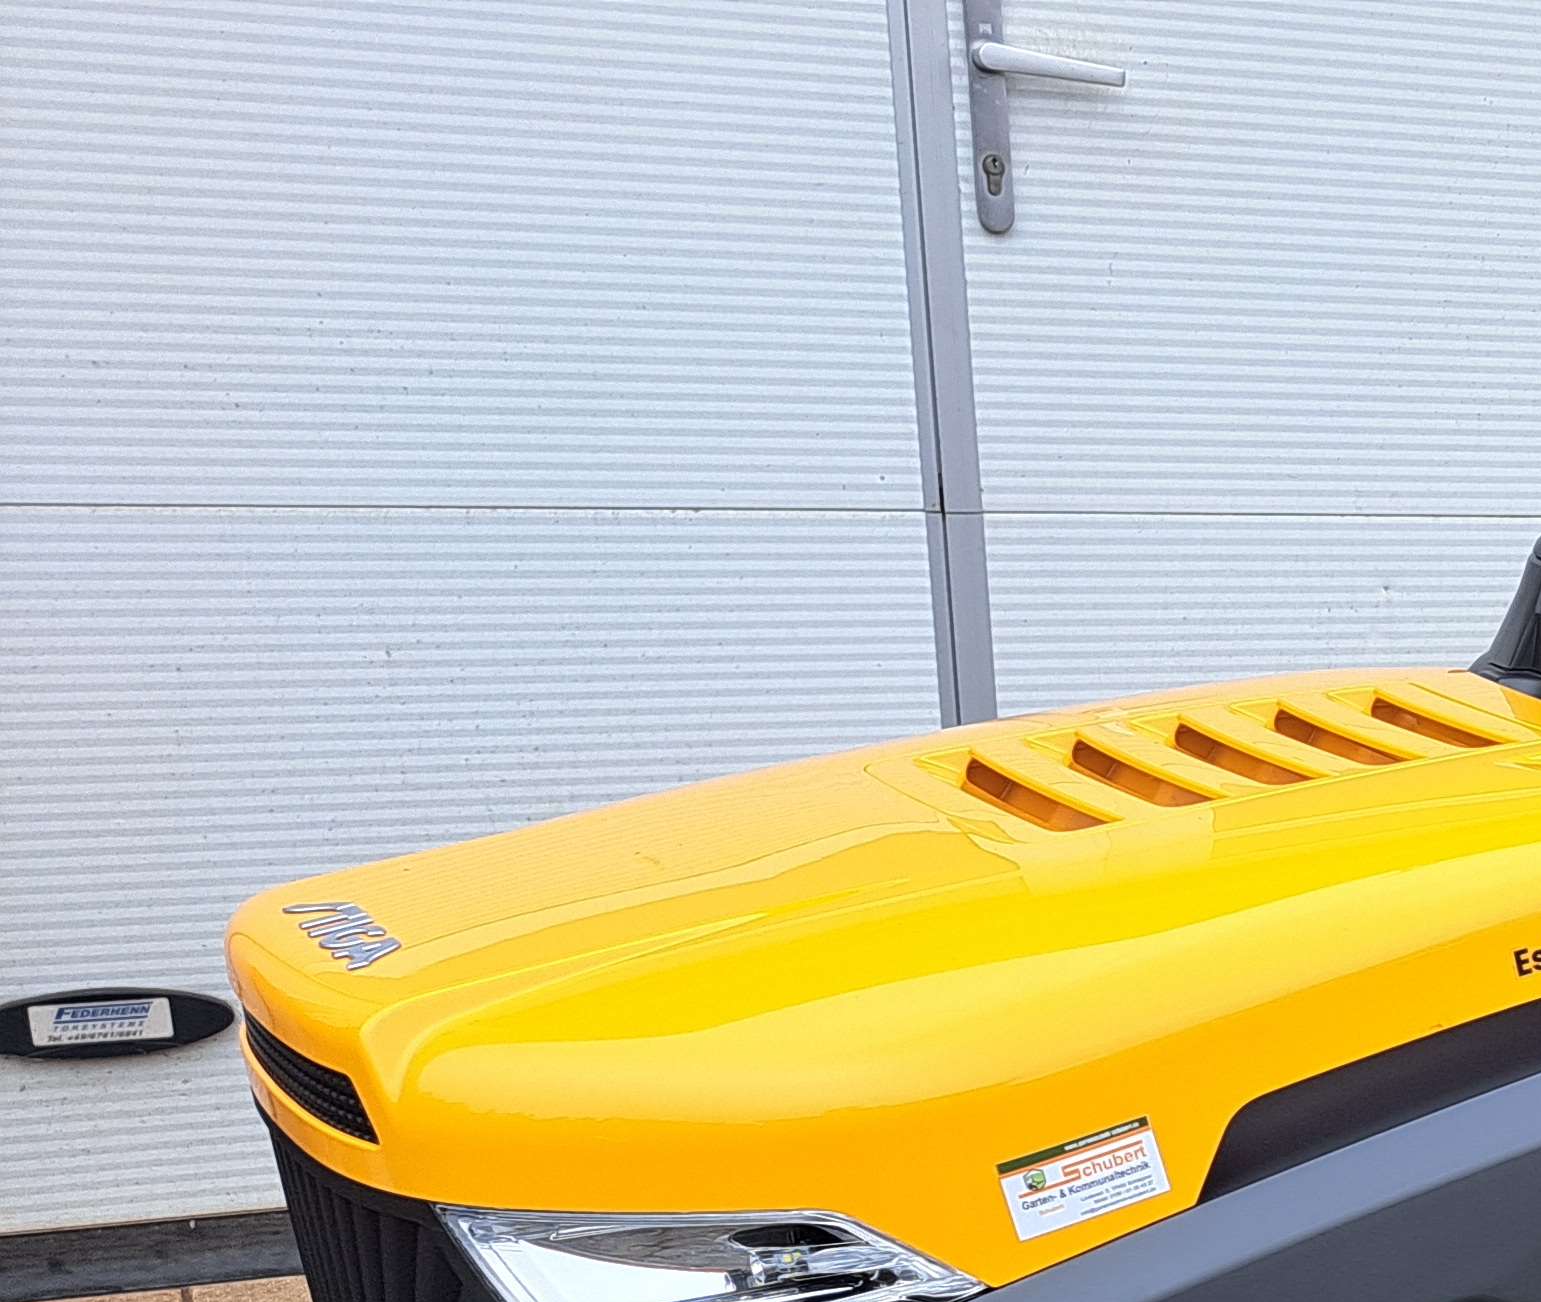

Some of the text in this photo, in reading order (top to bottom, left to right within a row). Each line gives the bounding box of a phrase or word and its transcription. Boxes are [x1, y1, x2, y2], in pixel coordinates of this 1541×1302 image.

[281, 901, 403, 971] STIGA
[55, 1003, 151, 1020] FEDERHENN
[1061, 1144, 1147, 1179] Schubert
[1021, 1194, 1057, 1211] Garten-
[1059, 1188, 1067, 1199] &
[1067, 1160, 1151, 1196] Kommunaltechnik
